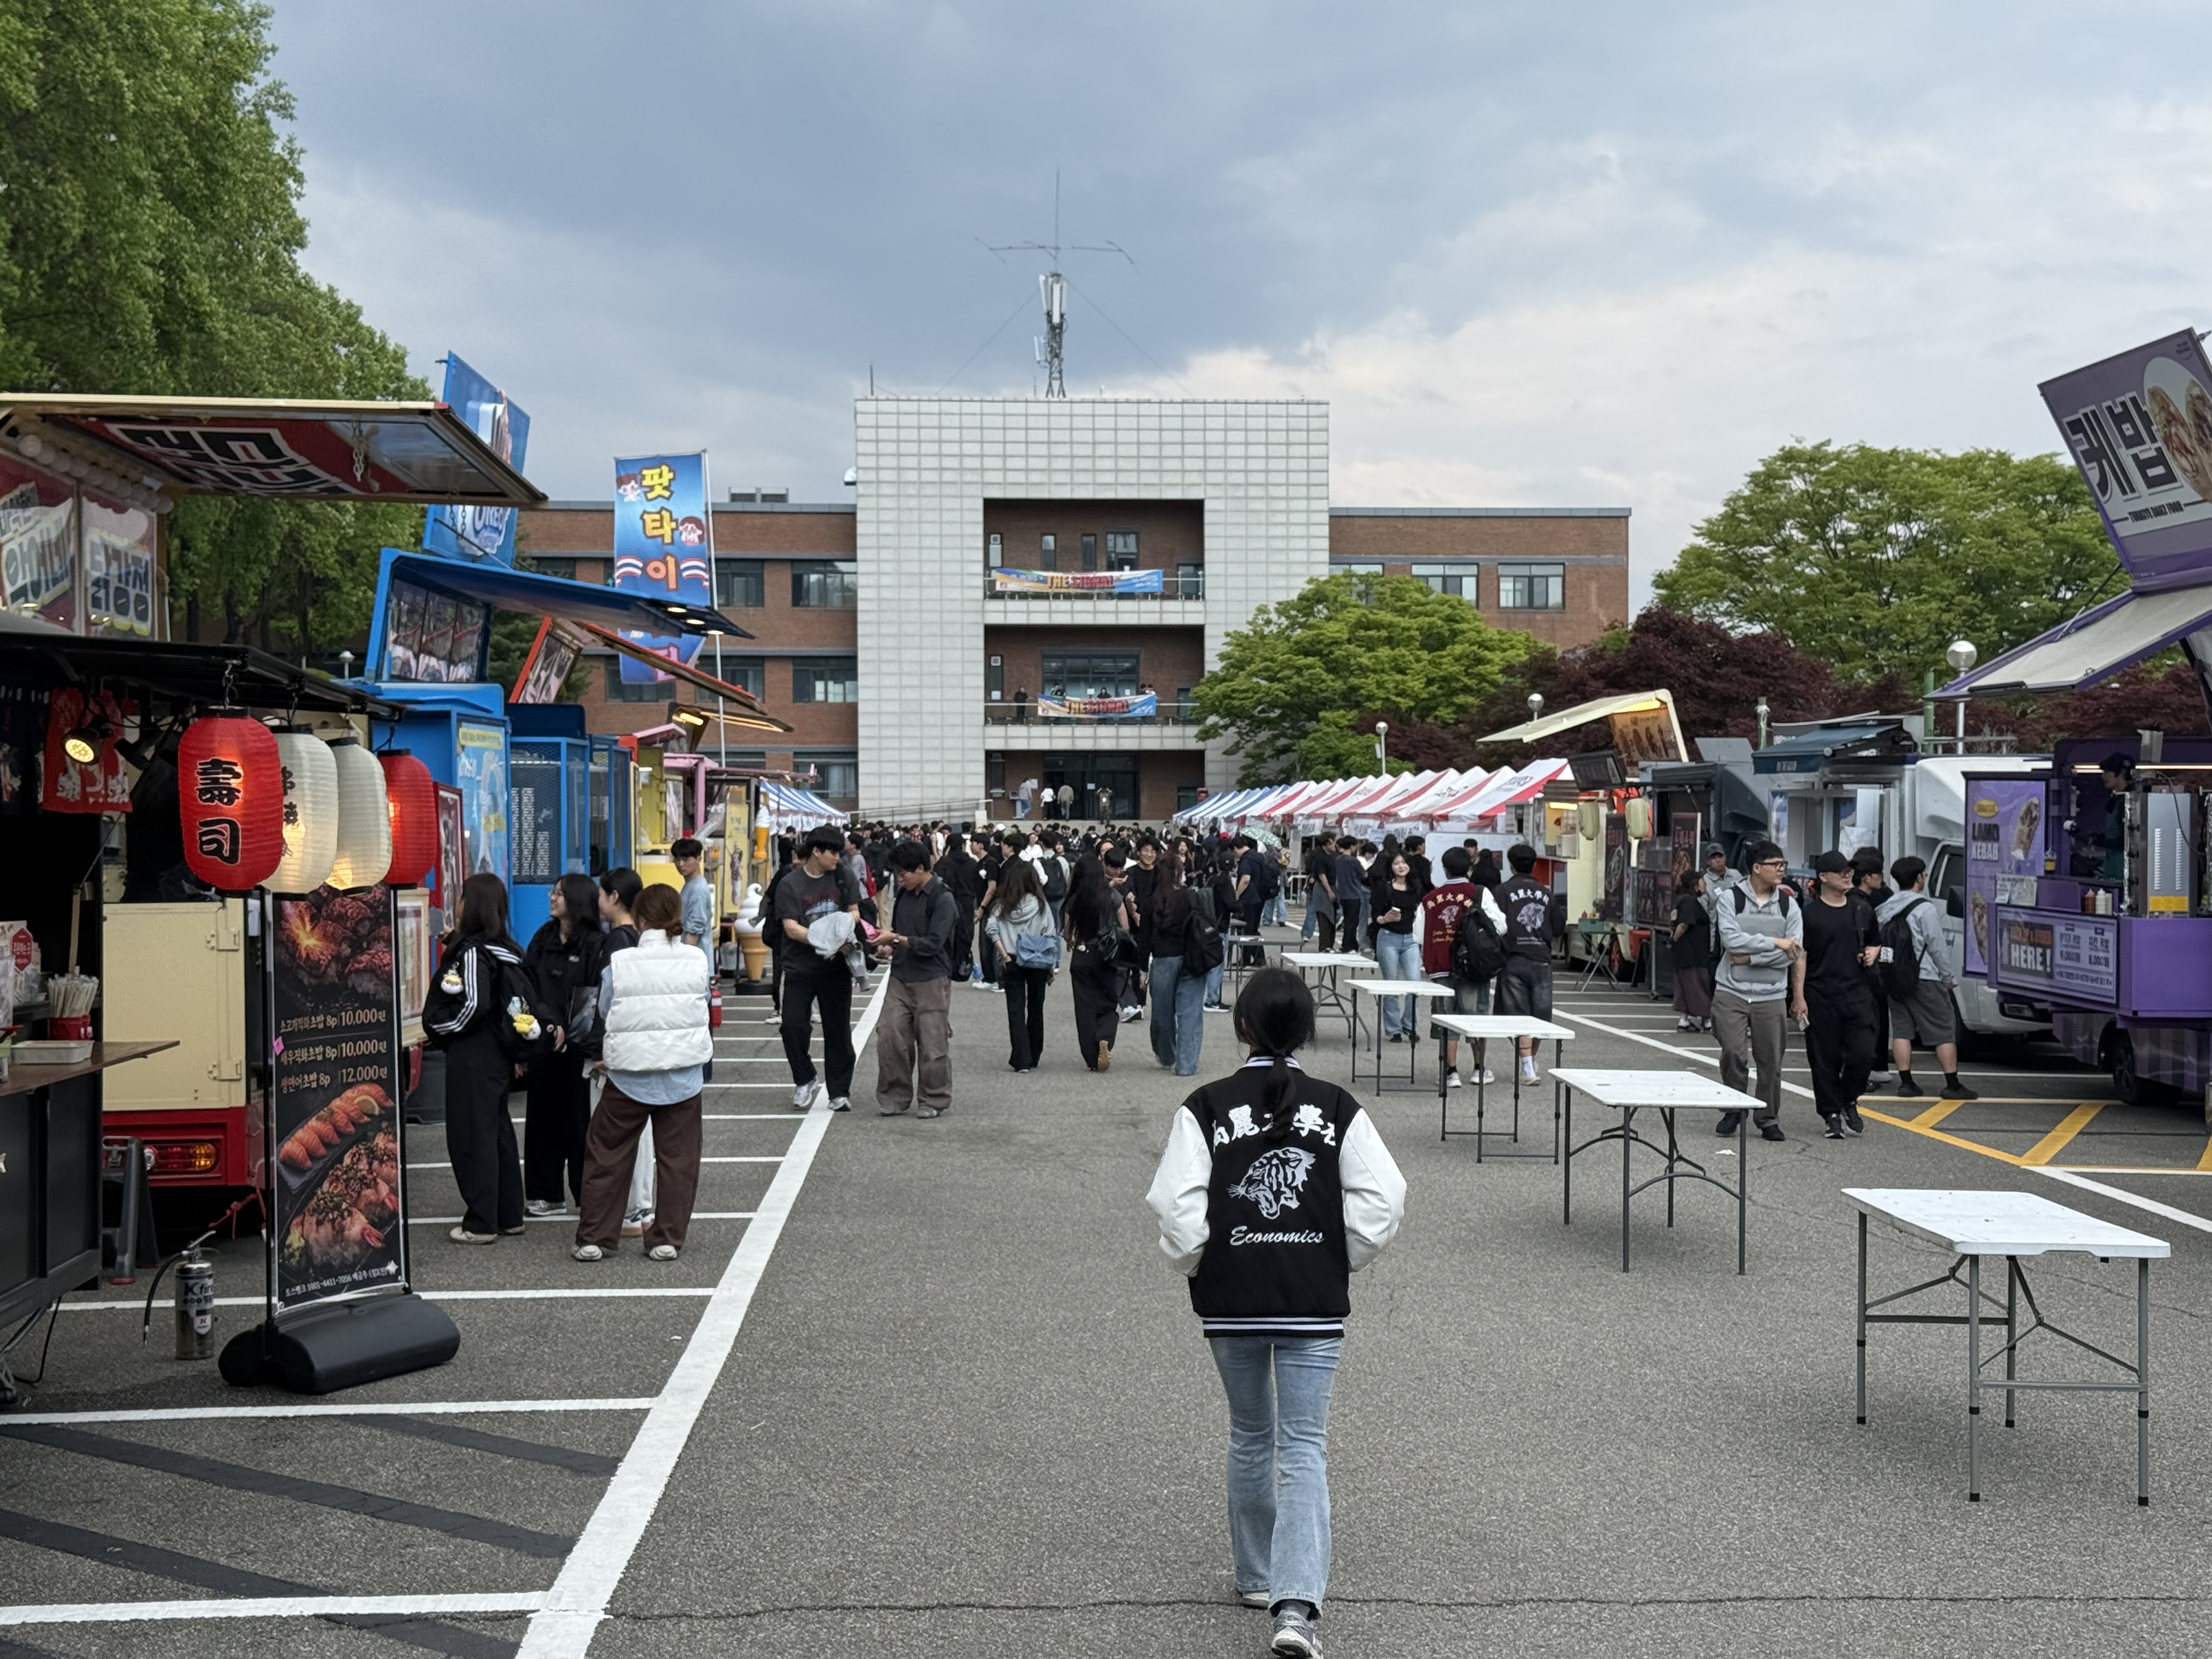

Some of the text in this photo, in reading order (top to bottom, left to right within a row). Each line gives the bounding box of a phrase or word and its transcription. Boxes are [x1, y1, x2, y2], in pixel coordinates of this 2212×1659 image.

[2064, 391, 2183, 503] 케밥
[641, 464, 679, 591] 팟타이
[1971, 842, 1999, 861] KEBAB
[341, 1008, 386, 1027] 10,000원
[341, 1039, 387, 1058] 10,000원
[319, 1073, 331, 1088] 8p
[341, 1065, 387, 1084] 12,000원
[1230, 1226, 1324, 1246] Economics
